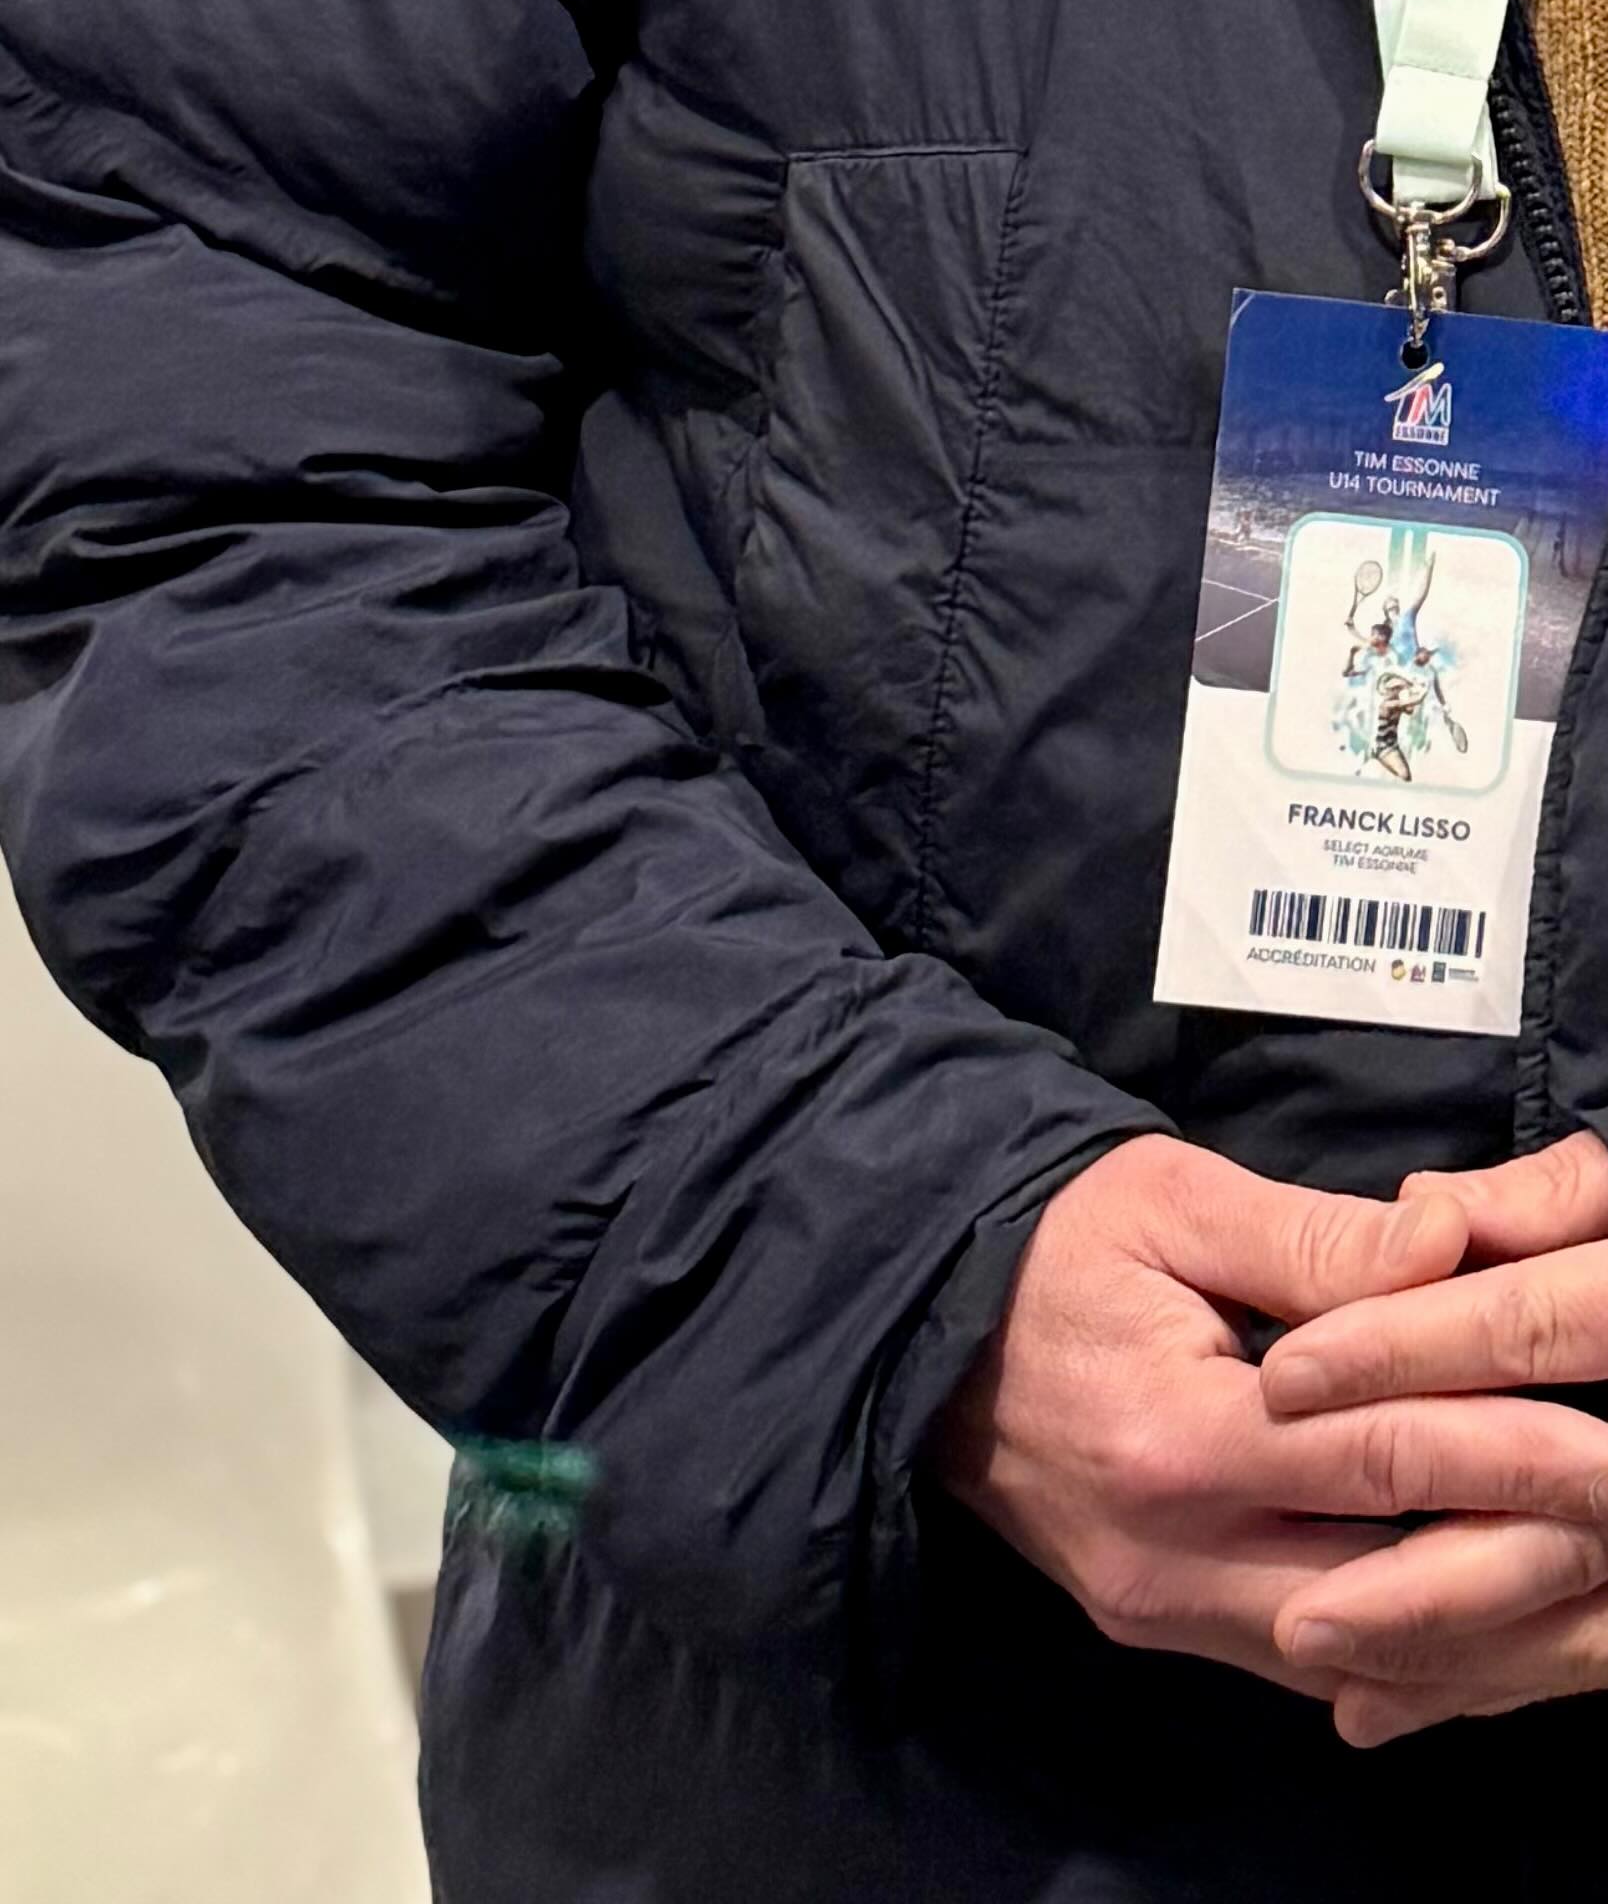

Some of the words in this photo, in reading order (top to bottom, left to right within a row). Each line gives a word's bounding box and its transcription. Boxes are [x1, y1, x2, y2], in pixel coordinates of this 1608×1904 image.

[1354, 450, 1387, 469] TIM
[1392, 455, 1481, 481] ESSONNE
[1329, 472, 1361, 490] U14
[1366, 476, 1501, 506] TOURNAMENT
[1288, 803, 1394, 835] FRANCK
[1399, 814, 1471, 842] LISSO
[1247, 947, 1377, 973] ACCRÉDITATION
